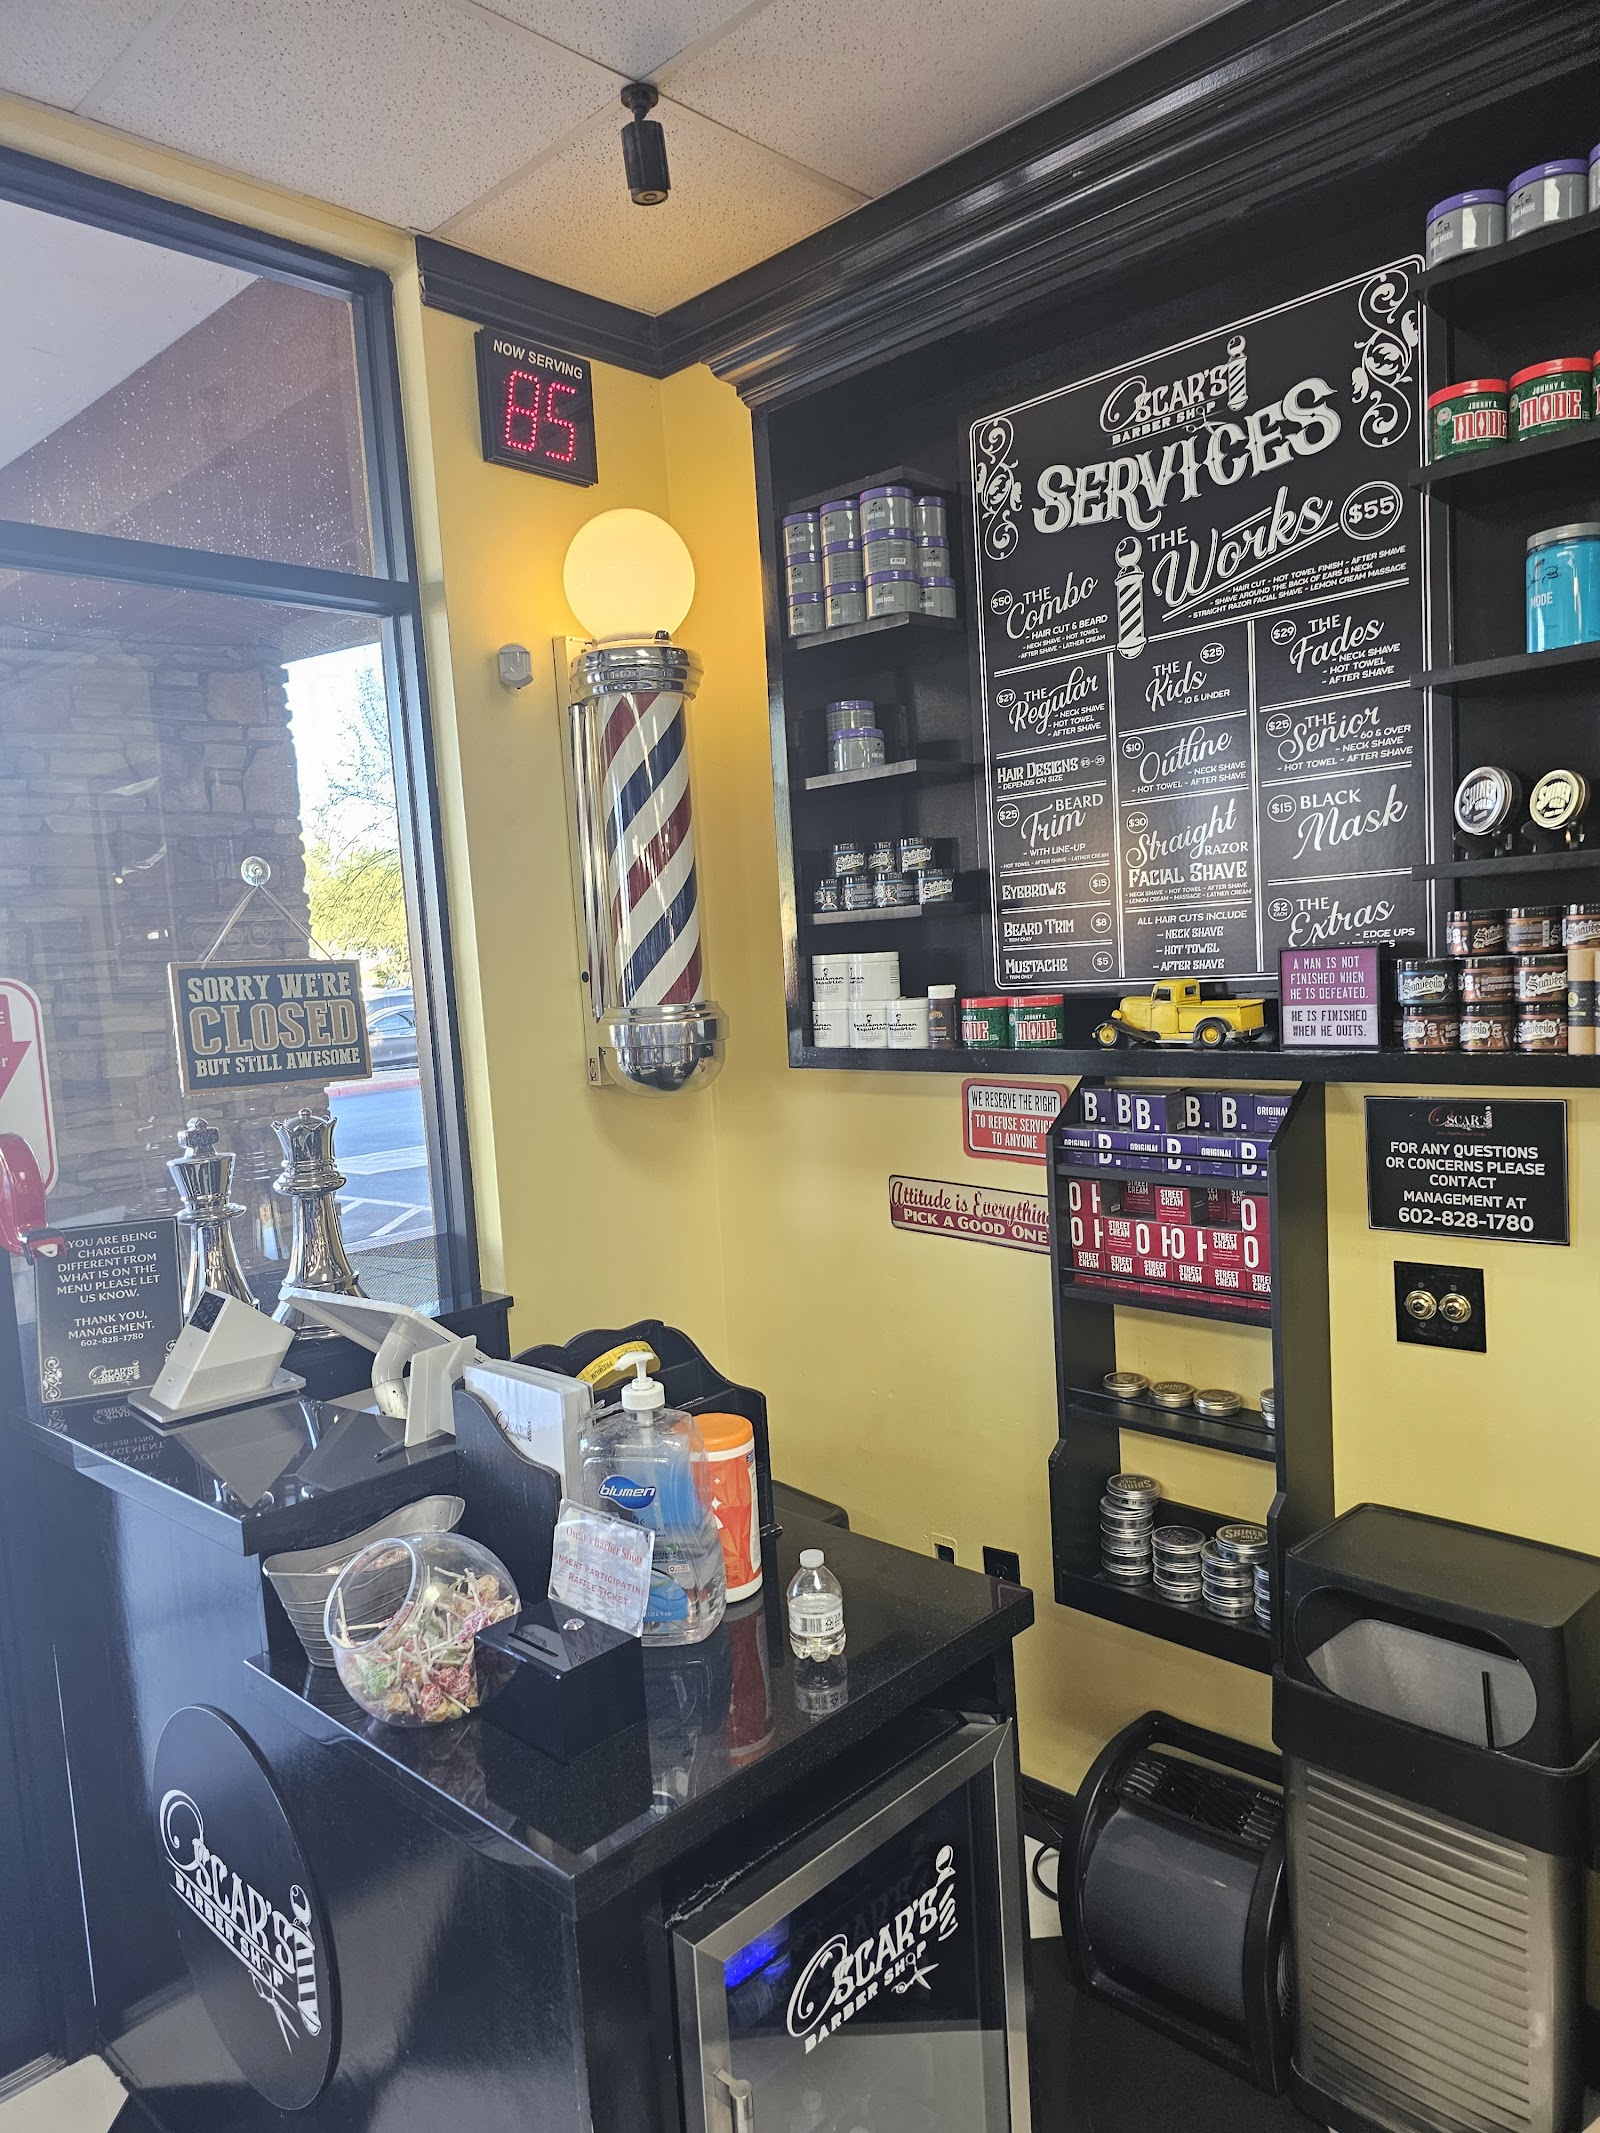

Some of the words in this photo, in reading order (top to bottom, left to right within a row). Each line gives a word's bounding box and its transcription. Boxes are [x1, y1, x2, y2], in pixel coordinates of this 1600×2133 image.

[494, 339, 525, 361] NOW
[528, 352, 583, 379] SERVING
[1532, 383, 1558, 395] JOHNNY
[505, 370, 576, 462] 85
[1519, 390, 1581, 431] MODE
[1111, 415, 1172, 445] BARBER
[1176, 401, 1216, 431] SHOP
[1452, 410, 1507, 444] MODE
[1032, 377, 1341, 533] SERVICES
[1348, 495, 1396, 524] $55
[1147, 526, 1189, 552] THE
[1152, 486, 1333, 607] Works
[1233, 583, 1249, 593] HAIR
[1250, 579, 1267, 590] CUT
[1273, 574, 1289, 584] HOT
[1291, 568, 1316, 580] TOWEL
[1318, 561, 1344, 573] FINISH
[1351, 552, 1377, 565] AFTER
[1378, 545, 1406, 558] SHAVE
[992, 596, 1011, 608] $50
[1007, 571, 1098, 639] Combo
[1023, 587, 1051, 604] THE
[1032, 628, 1051, 640] HAIR
[1053, 623, 1070, 634] CUT
[1079, 615, 1108, 629] BEARD
[1308, 614, 1341, 632] THE
[1290, 616, 1384, 673] Fades
[1339, 651, 1365, 662] NECK
[1368, 643, 1400, 656] SHAVE
[1153, 661, 1180, 676] THE
[1329, 671, 1359, 685] AFTER
[1362, 666, 1394, 678] SHAVE
[1330, 664, 1350, 674] HOT
[1353, 658, 1385, 669] TOWEL
[1024, 688, 1047, 701] THE
[1145, 661, 1207, 712] Kids
[999, 693, 1013, 703] $27
[1009, 666, 1098, 734] Regular
[1305, 712, 1336, 728] THE
[1278, 706, 1380, 762] Senior
[1126, 743, 1141, 752] $10
[1140, 726, 1232, 784] Outline
[997, 766, 1024, 783] HAIR
[1027, 757, 1079, 778] DESIGNS
[1056, 794, 1103, 811] BEARD
[1301, 789, 1361, 809] BLACK
[1021, 804, 1085, 847] Trim
[1129, 818, 1146, 827] $30
[1293, 784, 1408, 859] Mask
[1126, 798, 1236, 868] Straight
[1205, 842, 1249, 856] RAZOR
[1128, 868, 1184, 887] FACIAL
[1189, 861, 1248, 882] SHAVE
[1002, 882, 1066, 900] EYEBROWS
[1296, 897, 1330, 911] THE
[1137, 916, 1152, 925] ALL
[1155, 915, 1176, 924] HAIR
[1179, 912, 1203, 922] CUTS
[1206, 910, 1247, 920] INCLUDE
[1288, 901, 1395, 947] Extras
[1004, 922, 1042, 937] BEARD
[1044, 919, 1074, 933] TRIM
[1006, 958, 1067, 974] MUSTACHE
[1293, 959, 1298, 969] A
[1304, 958, 1320, 969] MAN
[1326, 957, 1337, 968] IS
[1342, 956, 1359, 967] NOT
[188, 975, 270, 1002] SORRY
[277, 972, 351, 998] WE'RE
[1291, 972, 1334, 984] FINISHED
[1340, 971, 1363, 983] WHEN
[1291, 989, 1301, 999] HE
[1306, 988, 1315, 999] IS
[1320, 987, 1368, 999] DEFEATED.
[1292, 1011, 1302, 1021] HE
[1307, 1010, 1317, 1021] IS
[1322, 1010, 1367, 1021] FINISHED
[189, 999, 359, 1055] CLOSED
[1016, 1019, 1057, 1041] MODE
[1293, 1026, 1316, 1036] WHEN
[1321, 1026, 1332, 1036] HE
[1337, 1025, 1366, 1036] QUITS.
[195, 1058, 230, 1077] BUT
[236, 1054, 282, 1074] STILL
[286, 1048, 360, 1069] AWESOME
[972, 1091, 983, 1106] WE
[985, 1092, 1016, 1109] RESERVE
[1019, 1094, 1032, 1110] THE
[1035, 1095, 1057, 1112] RIGHT
[975, 1114, 985, 1127] TO
[988, 1117, 1018, 1131] REFUSE
[992, 1132, 1002, 1145] TO
[1005, 1133, 1037, 1149] ANYONE
[1201, 1148, 1233, 1157] ORIGINAL
[1390, 1142, 1418, 1154] FOR
[1421, 1143, 1451, 1155] ANY
[1454, 1144, 1538, 1159] QUESTIONS
[1386, 1157, 1404, 1168] OR
[1408, 1158, 1483, 1173] CONCERNS
[1487, 1161, 1545, 1175] PLEASE
[1430, 1174, 1496, 1189] CONTACT
[892, 1181, 952, 1208] Attitude
[956, 1194, 968, 1212] is
[1160, 1189, 1183, 1199] STREET
[1162, 1197, 1183, 1206] CREAM
[1404, 1191, 1503, 1208] MANAGEMENT
[1506, 1197, 1526, 1209] AT
[904, 1209, 939, 1225] PICK
[943, 1218, 954, 1227] A
[958, 1217, 1005, 1235] GOOD
[1012, 1224, 1048, 1243] ONE
[1399, 1207, 1534, 1232] 602-828-1780
[67, 1239, 93, 1249] YOU
[96, 1235, 119, 1246] ARE
[122, 1231, 157, 1243] BEING
[78, 1245, 135, 1259] CHARGED
[58, 1258, 121, 1272] DIFFERENT
[124, 1253, 157, 1264] FROM
[59, 1272, 96, 1283] WHAT
[98, 1269, 109, 1278] IS
[112, 1267, 131, 1277] ON
[133, 1264, 156, 1274] THE
[57, 1283, 92, 1295] MENU
[95, 1279, 137, 1290] PLEASE
[140, 1275, 160, 1285] LET
[80, 1294, 96, 1303] US
[99, 1289, 139, 1301] KNOW.
[74, 1314, 116, 1327] THANK
[68, 1321, 155, 1340] MANAGEMENT.
[81, 1332, 144, 1346] 602-828-1780
[600, 1484, 655, 1497] blumen
[567, 1526, 592, 1544] Oscar's
[594, 1537, 619, 1555] Barber
[621, 1547, 643, 1567] Shop
[555, 1553, 583, 1570] INSERT
[569, 1573, 597, 1592] RAFFLE
[599, 1586, 630, 1605] TICKET
[175, 1871, 235, 1949] BARBER
[240, 1939, 284, 1987] SHOP
[804, 1981, 878, 2054] BARBER
[884, 1940, 927, 1986] SHOP
